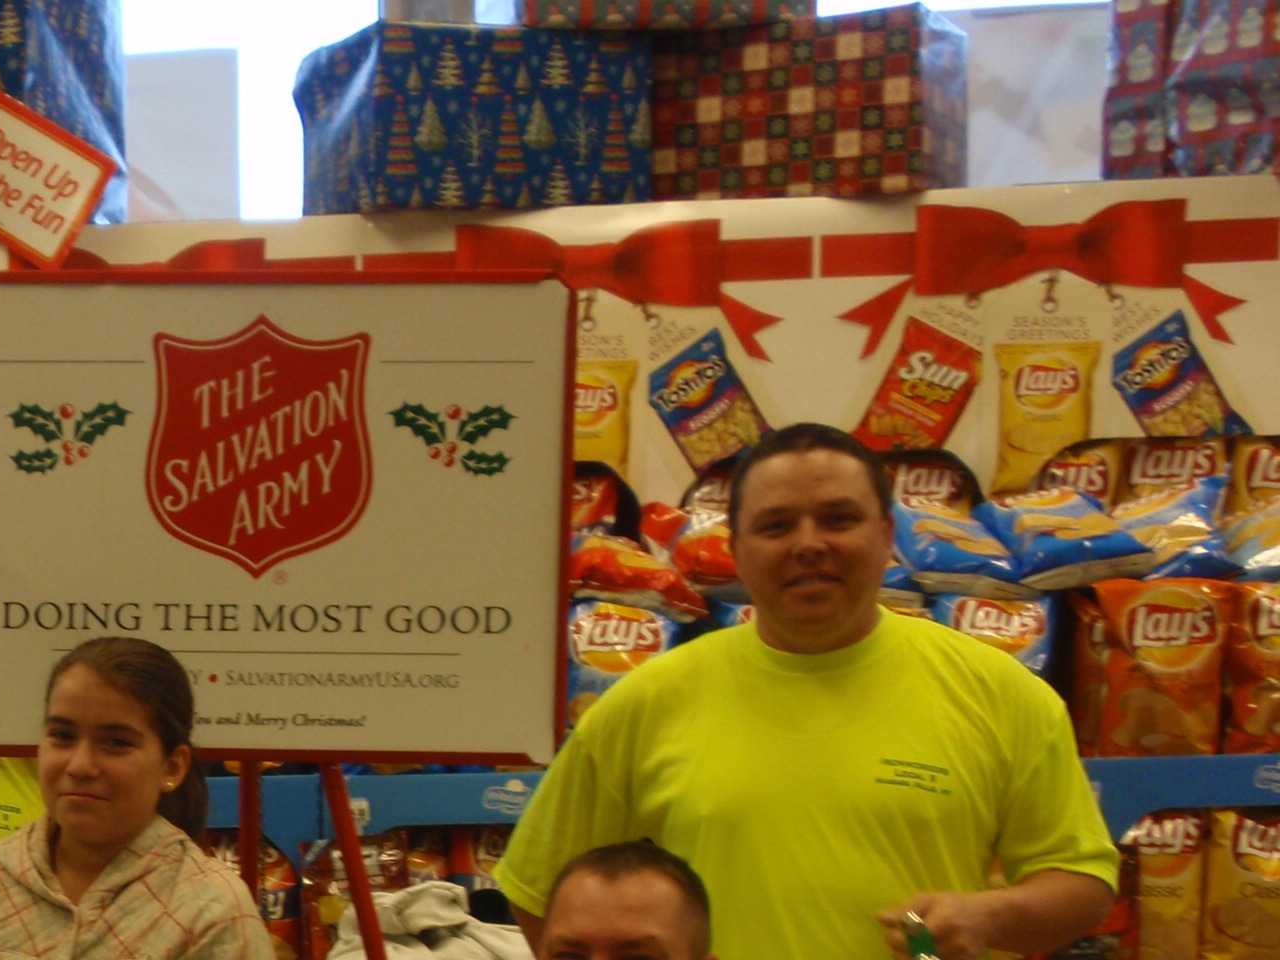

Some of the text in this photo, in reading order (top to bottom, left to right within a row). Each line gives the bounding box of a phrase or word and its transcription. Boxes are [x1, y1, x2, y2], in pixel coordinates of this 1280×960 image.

[43, 163, 80, 202] Up
[18, 193, 66, 235] Fun
[576, 334, 624, 346] SON'S
[1006, 329, 1091, 341] GREETINGS
[1012, 315, 1088, 328] SEASON'S
[576, 348, 628, 359] ETINGS
[897, 350, 970, 392] Sun
[1119, 336, 1190, 394] Tostitos
[193, 355, 277, 430] THE
[575, 384, 615, 414] ay's
[651, 354, 727, 413] Tostitos
[1016, 366, 1079, 398] Lay's
[162, 368, 350, 513] SALVATION
[1130, 441, 1217, 486] Lay's
[227, 439, 343, 546] ARMY
[2, 600, 513, 635] DOING THE MOST GOOD
[576, 611, 657, 652] Lay's
[956, 601, 1042, 634] Lay's
[1132, 604, 1215, 647] Lay's
[225, 669, 460, 689] SALVATIONARMYUSA.ORG
[215, 712, 241, 725] and
[245, 713, 288, 730] Merry
[291, 712, 367, 728] Christmas!
[1239, 881, 1280, 899] Clas
